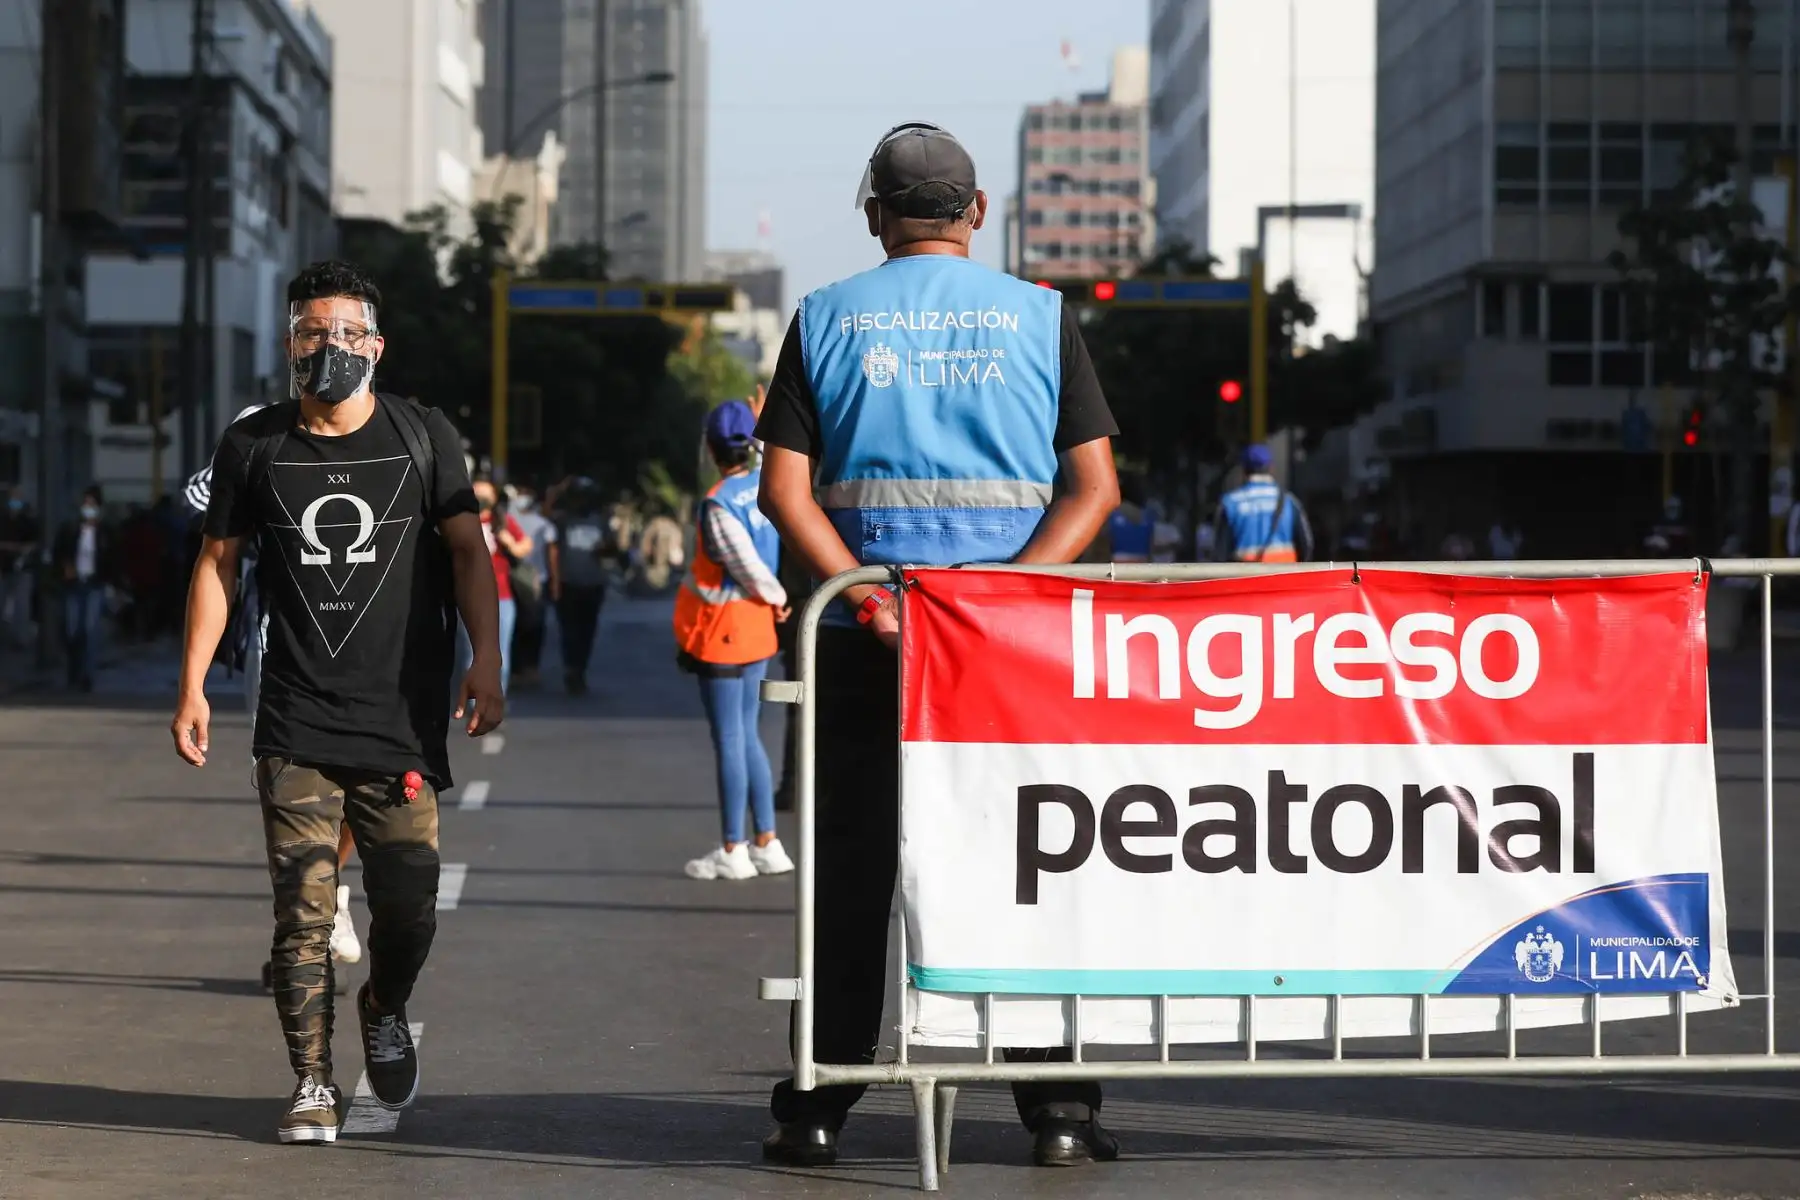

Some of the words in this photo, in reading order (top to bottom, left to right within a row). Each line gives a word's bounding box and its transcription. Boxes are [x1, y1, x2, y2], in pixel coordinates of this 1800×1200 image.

[840, 305, 1019, 335] FISCALIZACIÓN
[920, 349, 988, 360] MUNICIPALIDAD
[992, 349, 1005, 358] DE
[921, 362, 1005, 386] LIMA
[327, 474, 350, 484] XXI
[319, 602, 355, 611] MMXV
[1071, 588, 1540, 730] Ingreso
[1016, 752, 1595, 905] peatonal
[1590, 936, 1682, 947] MUNICIPALIDAD
[1684, 936, 1699, 946] DE
[1590, 951, 1701, 979] LIMA
